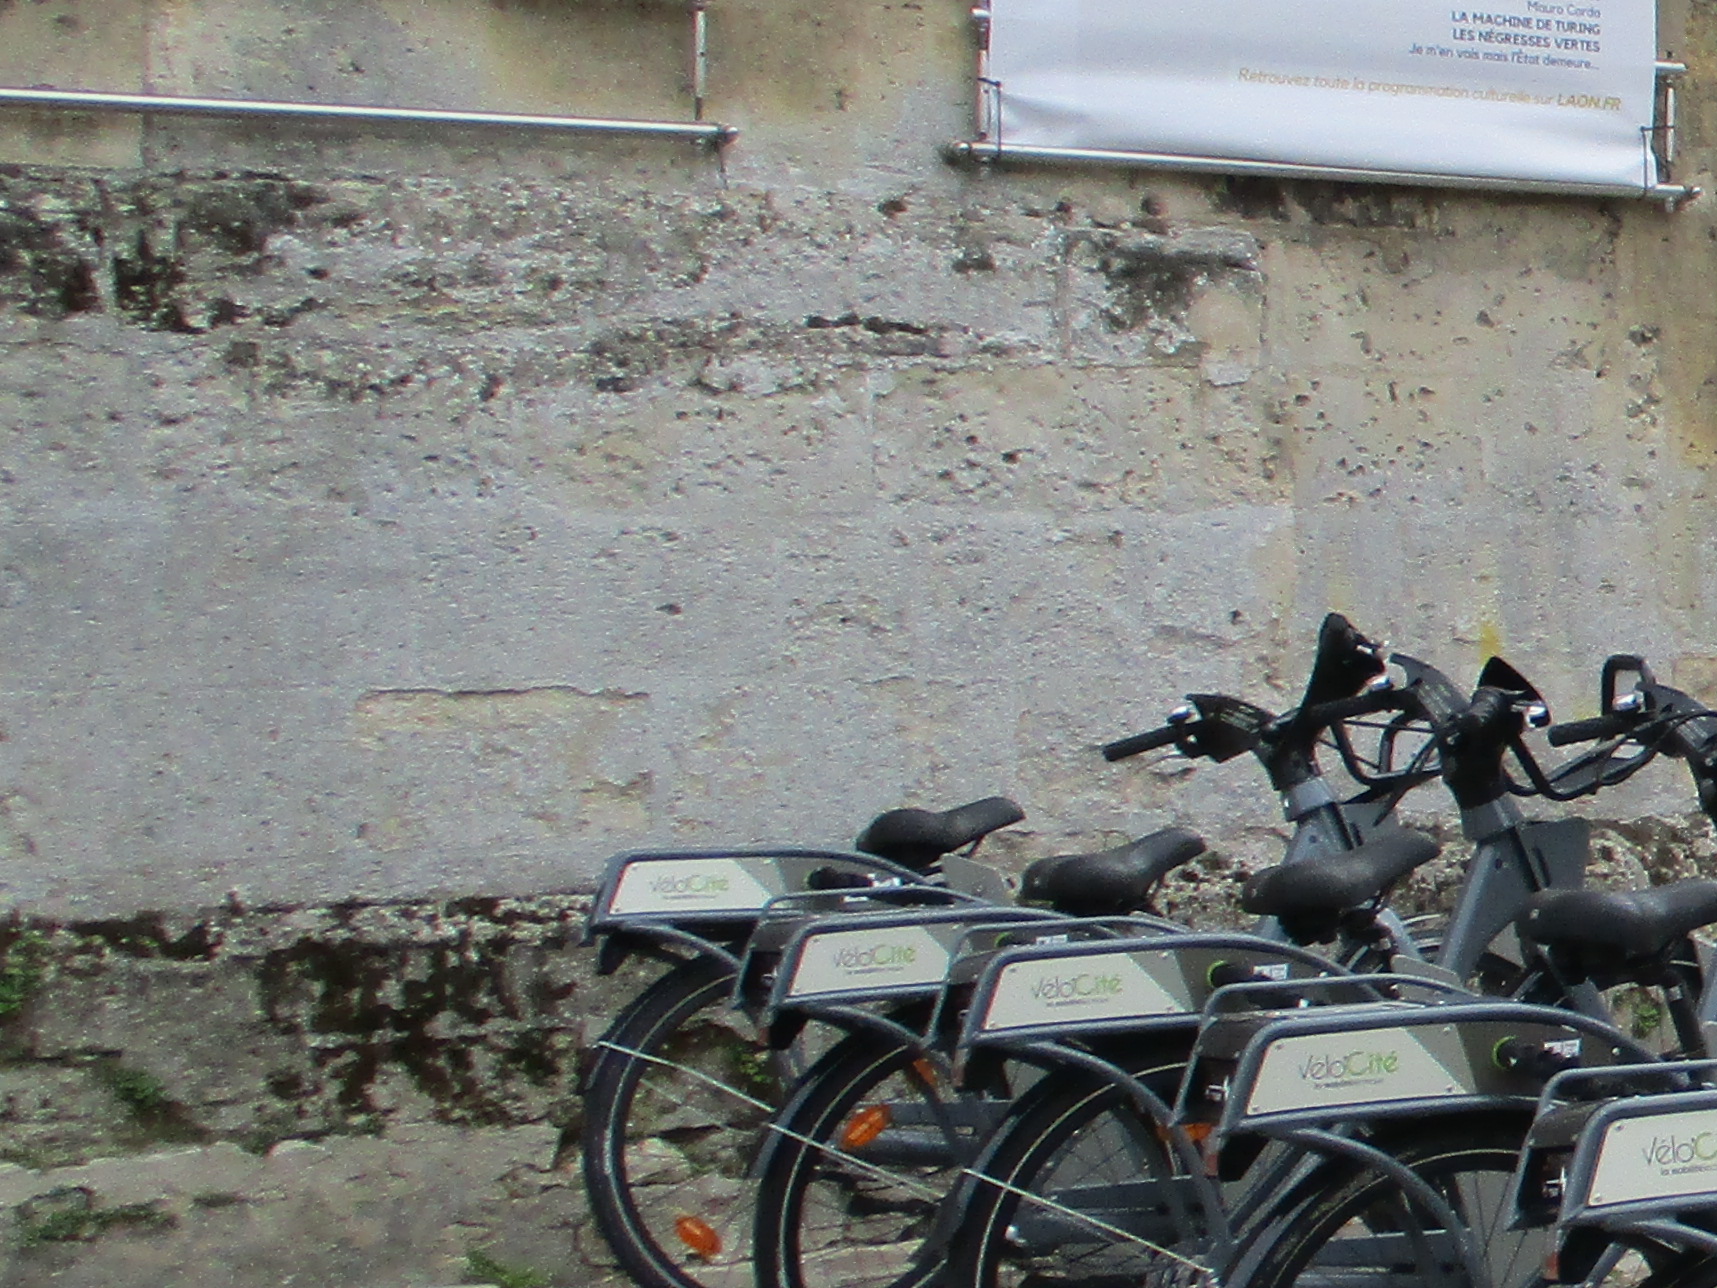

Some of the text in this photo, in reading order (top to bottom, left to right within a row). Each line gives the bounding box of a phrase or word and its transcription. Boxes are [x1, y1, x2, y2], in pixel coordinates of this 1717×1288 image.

[1451, 10, 1600, 35] LA MACHINE DE TURING
[1453, 27, 1599, 52] LES NÉGRESSES VERTES
